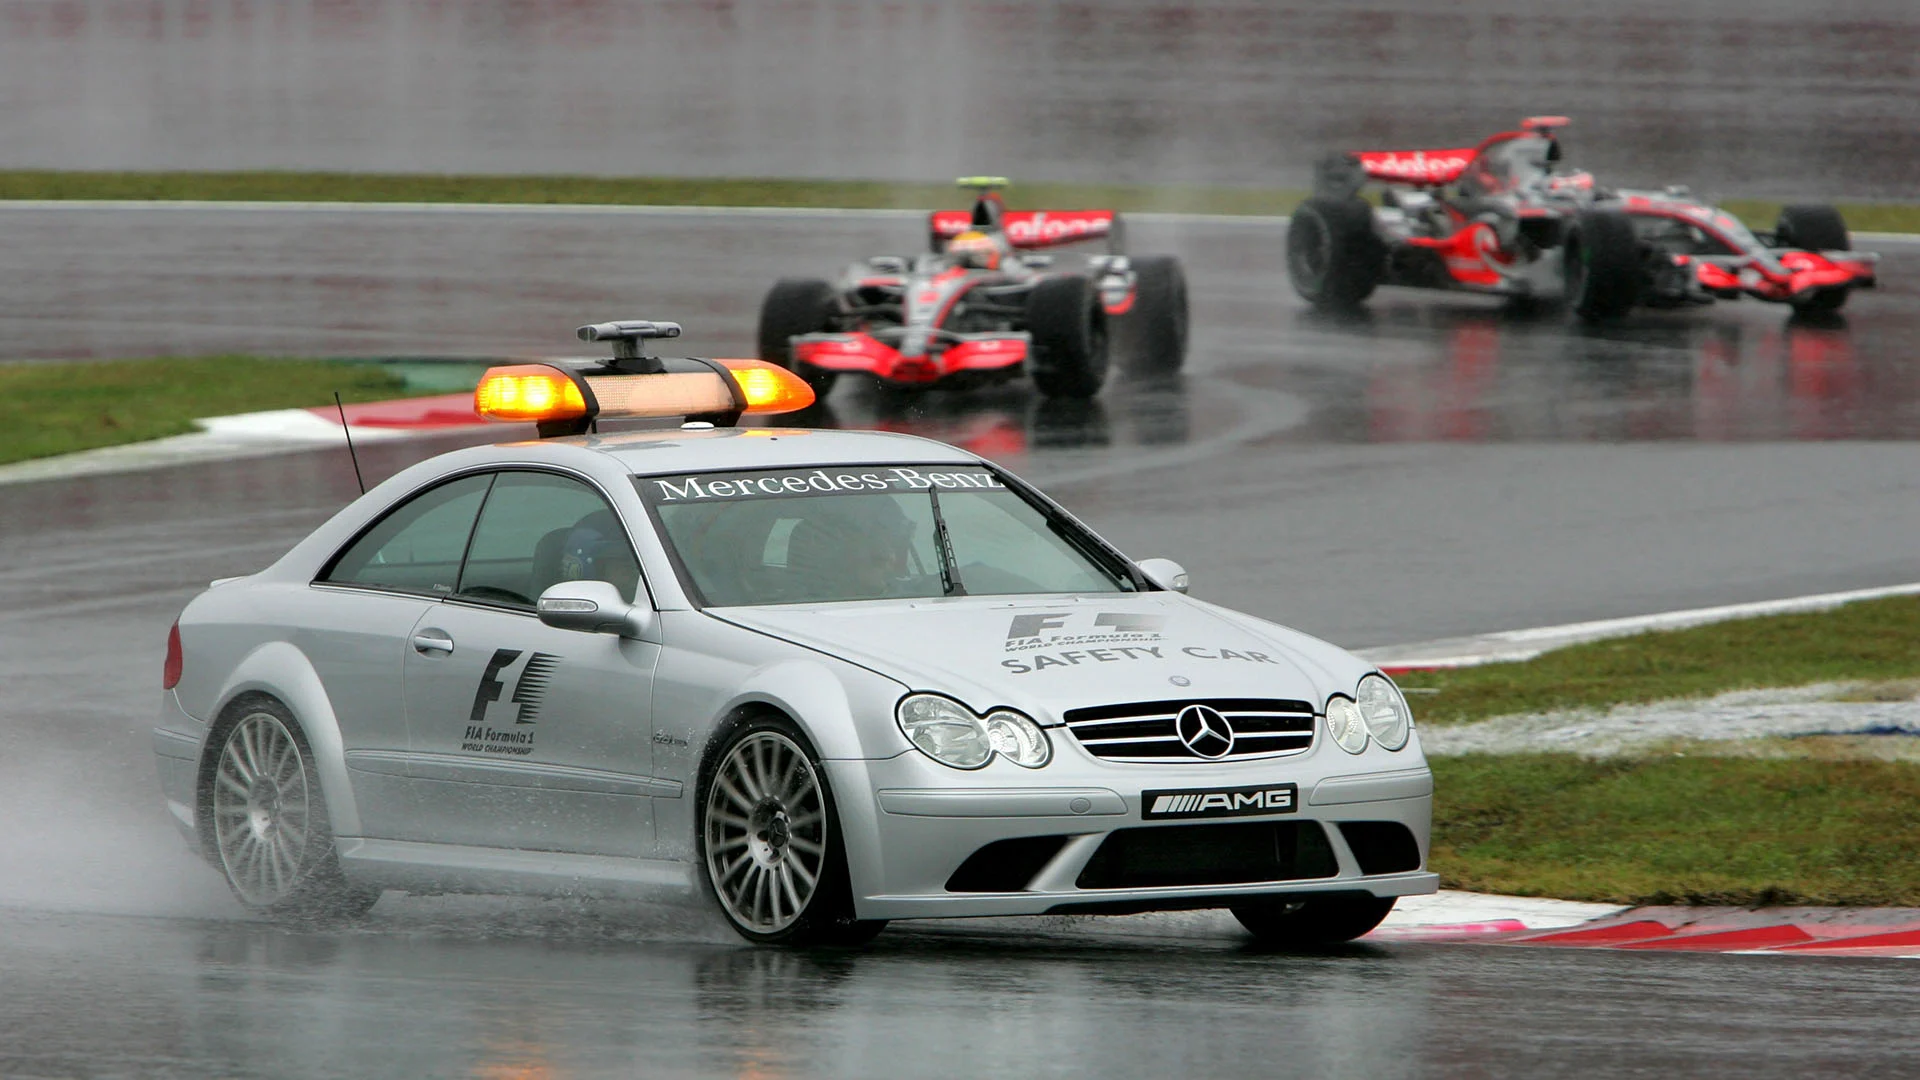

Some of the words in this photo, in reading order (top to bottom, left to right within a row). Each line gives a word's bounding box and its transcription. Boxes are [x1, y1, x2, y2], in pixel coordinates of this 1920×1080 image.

[652, 468, 1006, 500] Mercedes-Benz
[1005, 638, 1042, 647] FIA
[1051, 633, 1143, 643] Formula
[1005, 643, 1052, 652] WORLD
[1001, 646, 1163, 674] SAFETY
[1182, 646, 1280, 665] CAR
[470, 648, 565, 724] F1
[465, 726, 483, 740] FIA
[485, 728, 526, 744] Formula
[528, 731, 535, 744] 1
[461, 742, 484, 752] WORLD
[1198, 789, 1291, 812] AMG
